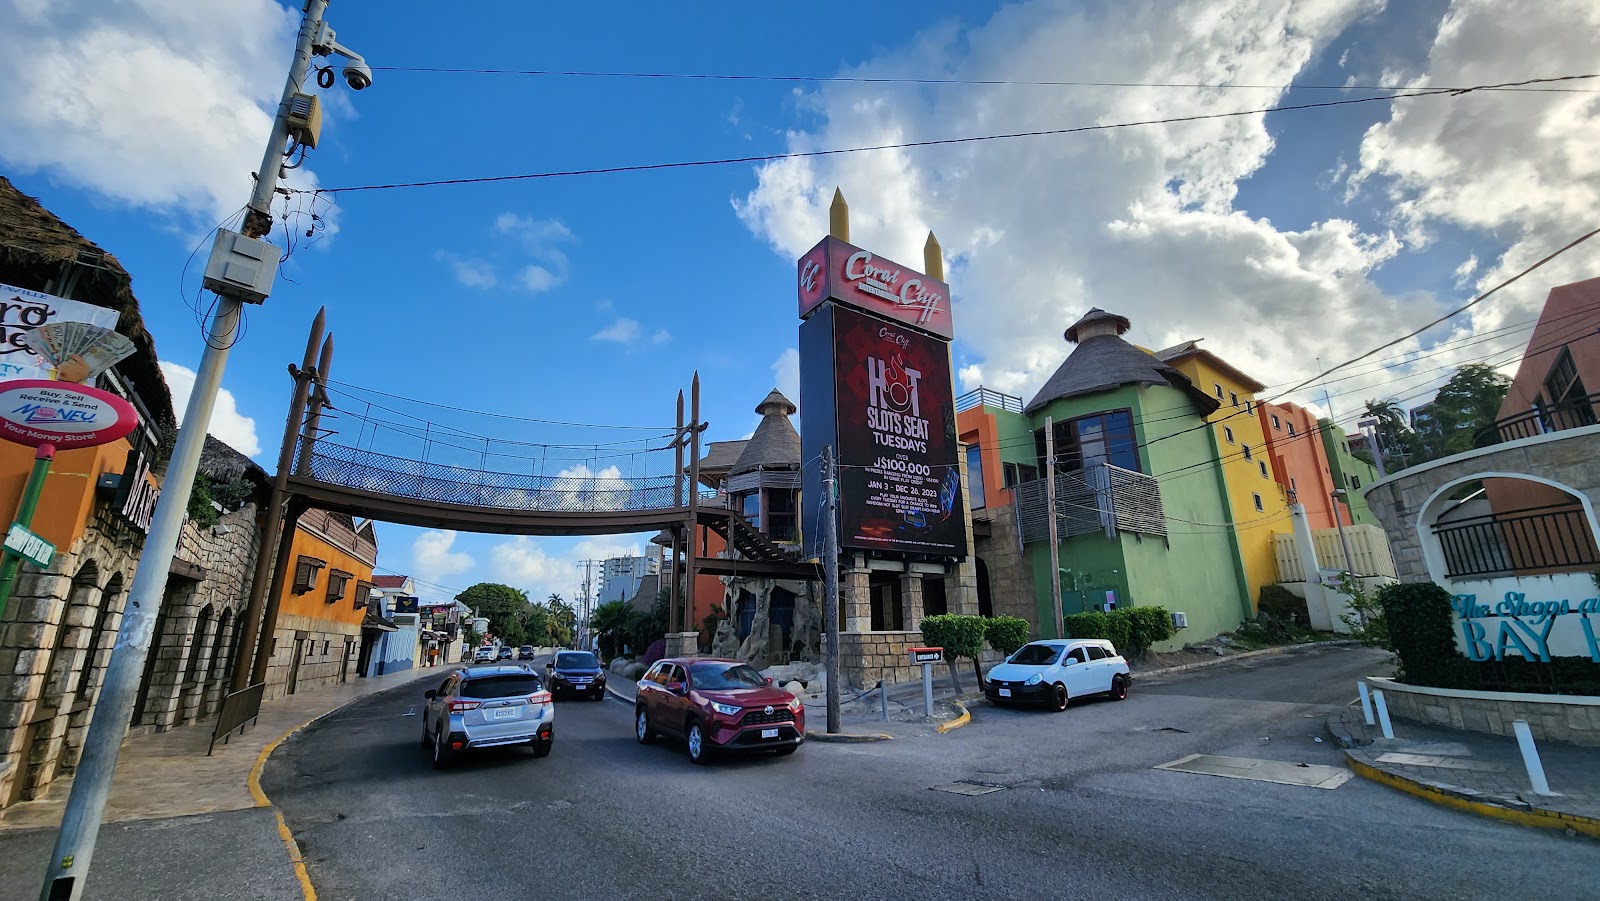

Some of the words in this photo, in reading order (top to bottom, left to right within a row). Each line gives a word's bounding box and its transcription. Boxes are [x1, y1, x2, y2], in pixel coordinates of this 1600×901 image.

[846, 251, 900, 283] Coral
[900, 279, 943, 323] Cliff
[879, 327, 896, 338] Coral
[895, 335, 910, 349] Cliff
[868, 355, 922, 417] HOT
[20, 393, 61, 404] Receive
[71, 401, 98, 410] Send
[64, 393, 84, 402] Sell
[3, 421, 26, 435] Your
[26, 430, 63, 443] Money
[64, 432, 97, 442] Store!
[867, 406, 902, 434] SLOTS
[903, 414, 929, 440] SEAT
[873, 431, 927, 453] TUESDAYS
[874, 456, 930, 476] J$100,000
[896, 453, 909, 461] OVER
[867, 480, 882, 489] JAN
[895, 485, 908, 493] DEC
[922, 488, 937, 498] 2023
[1451, 594, 1491, 619] The
[1495, 591, 1570, 625] Shops
[1461, 620, 1551, 663] BAY
